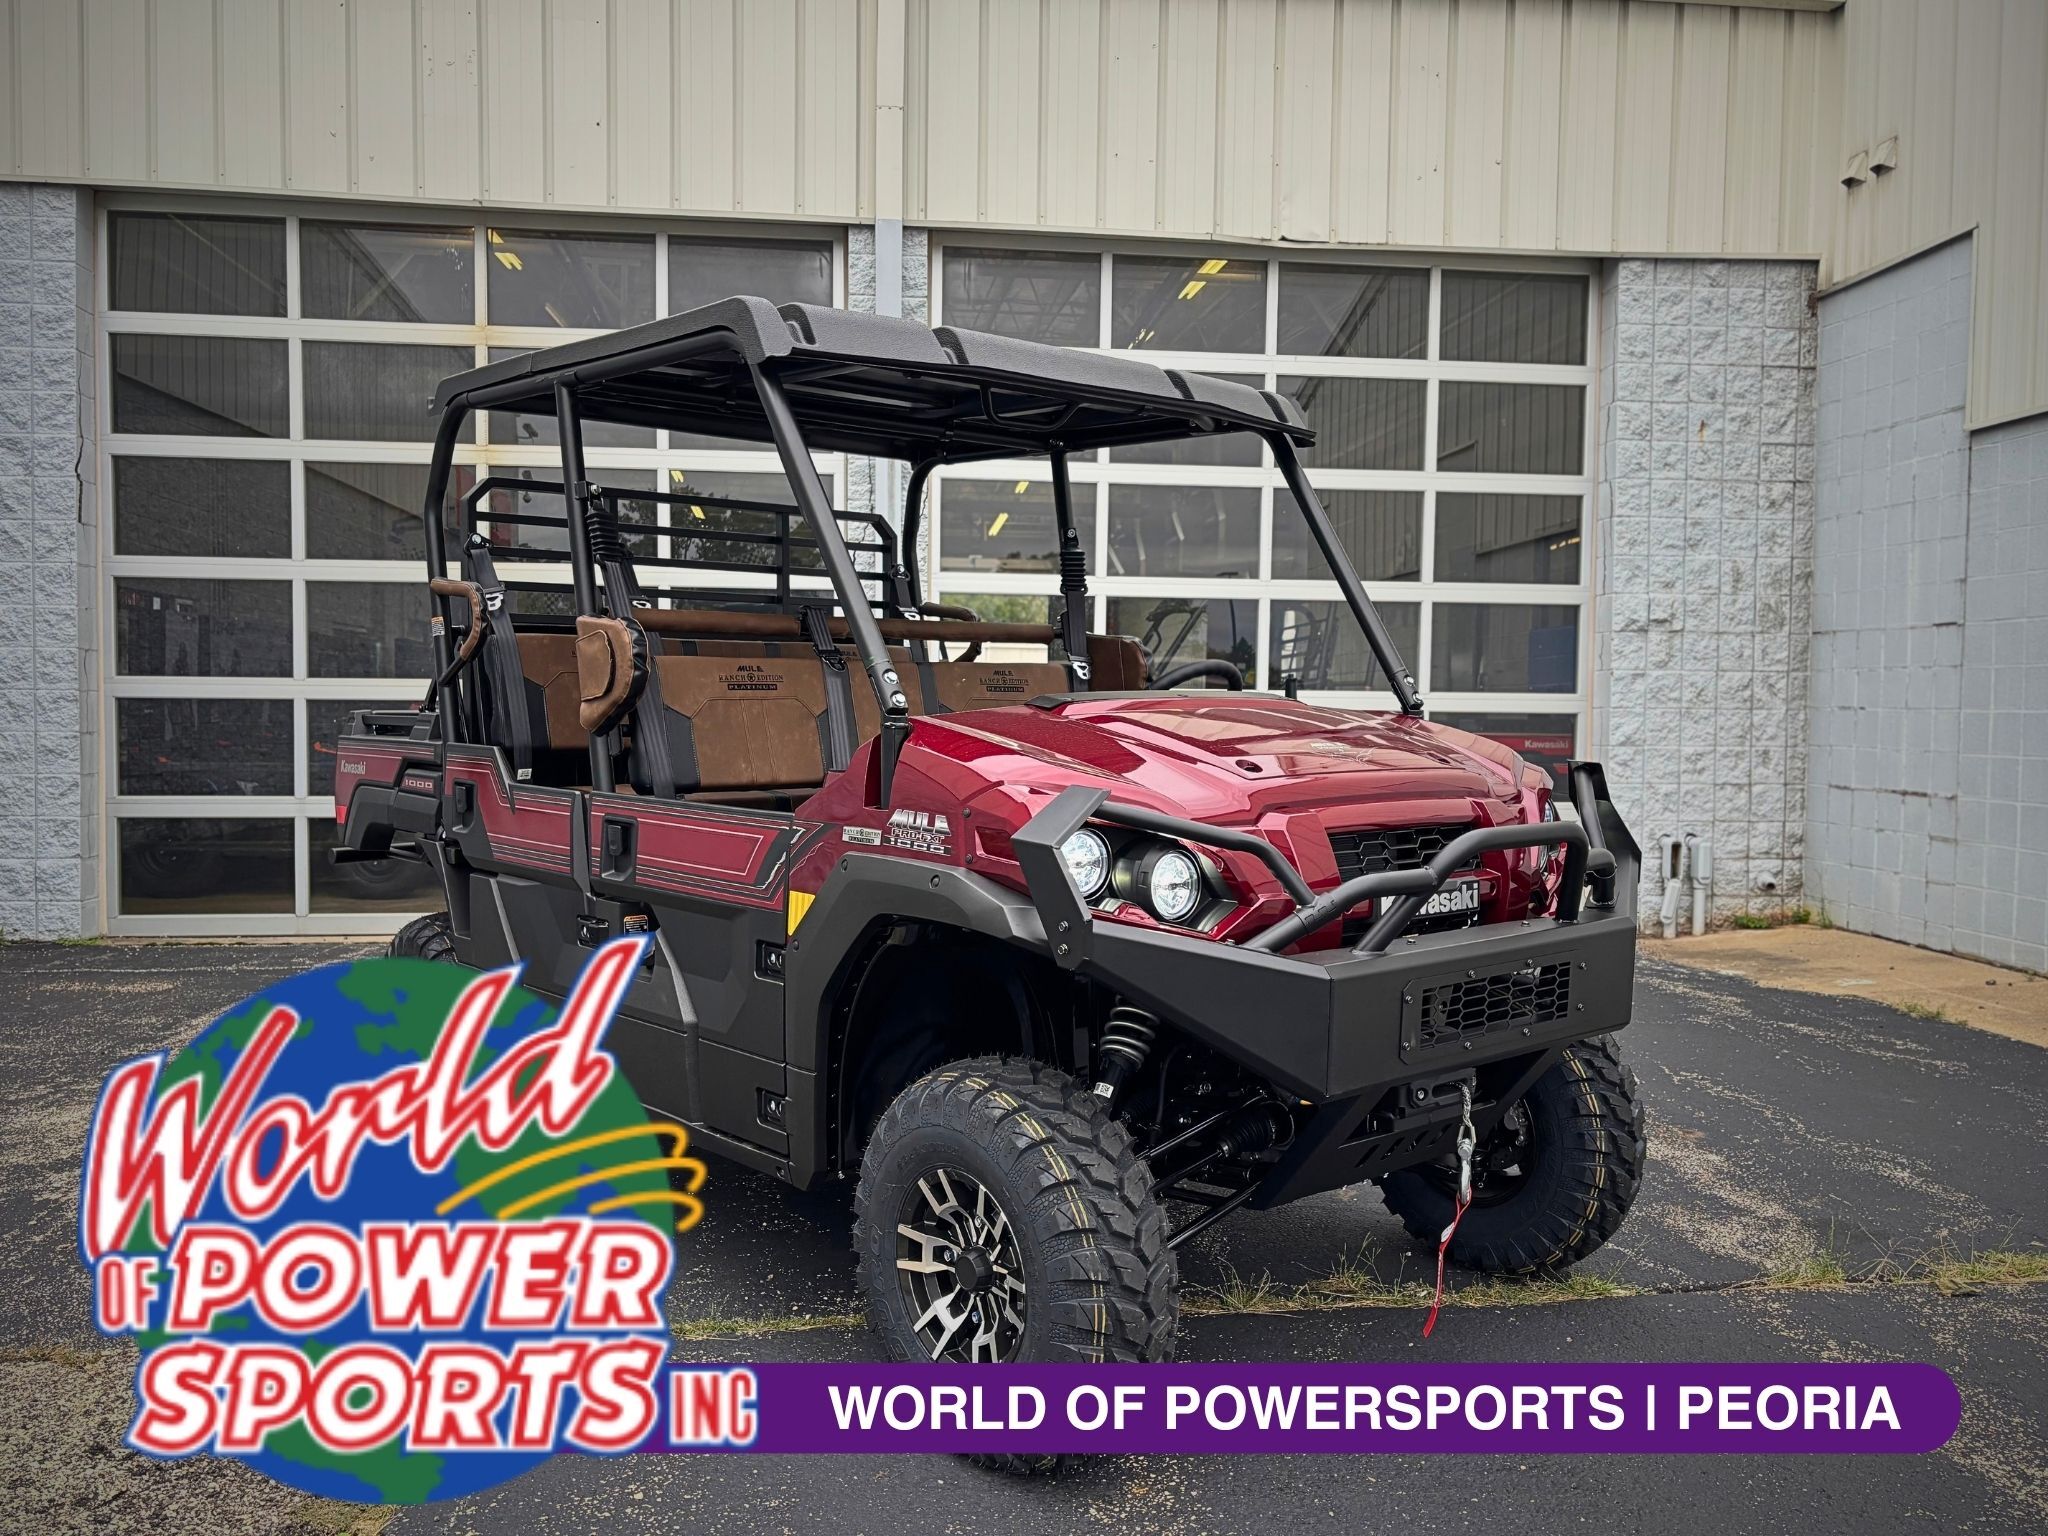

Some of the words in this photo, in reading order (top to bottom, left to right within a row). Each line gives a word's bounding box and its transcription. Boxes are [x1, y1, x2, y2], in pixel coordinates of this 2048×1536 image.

[1524, 740, 1569, 749] Kawasaki
[341, 760, 366, 775] Kawasaki
[405, 779, 433, 789] 1000
[1381, 883, 1479, 916] asaki
